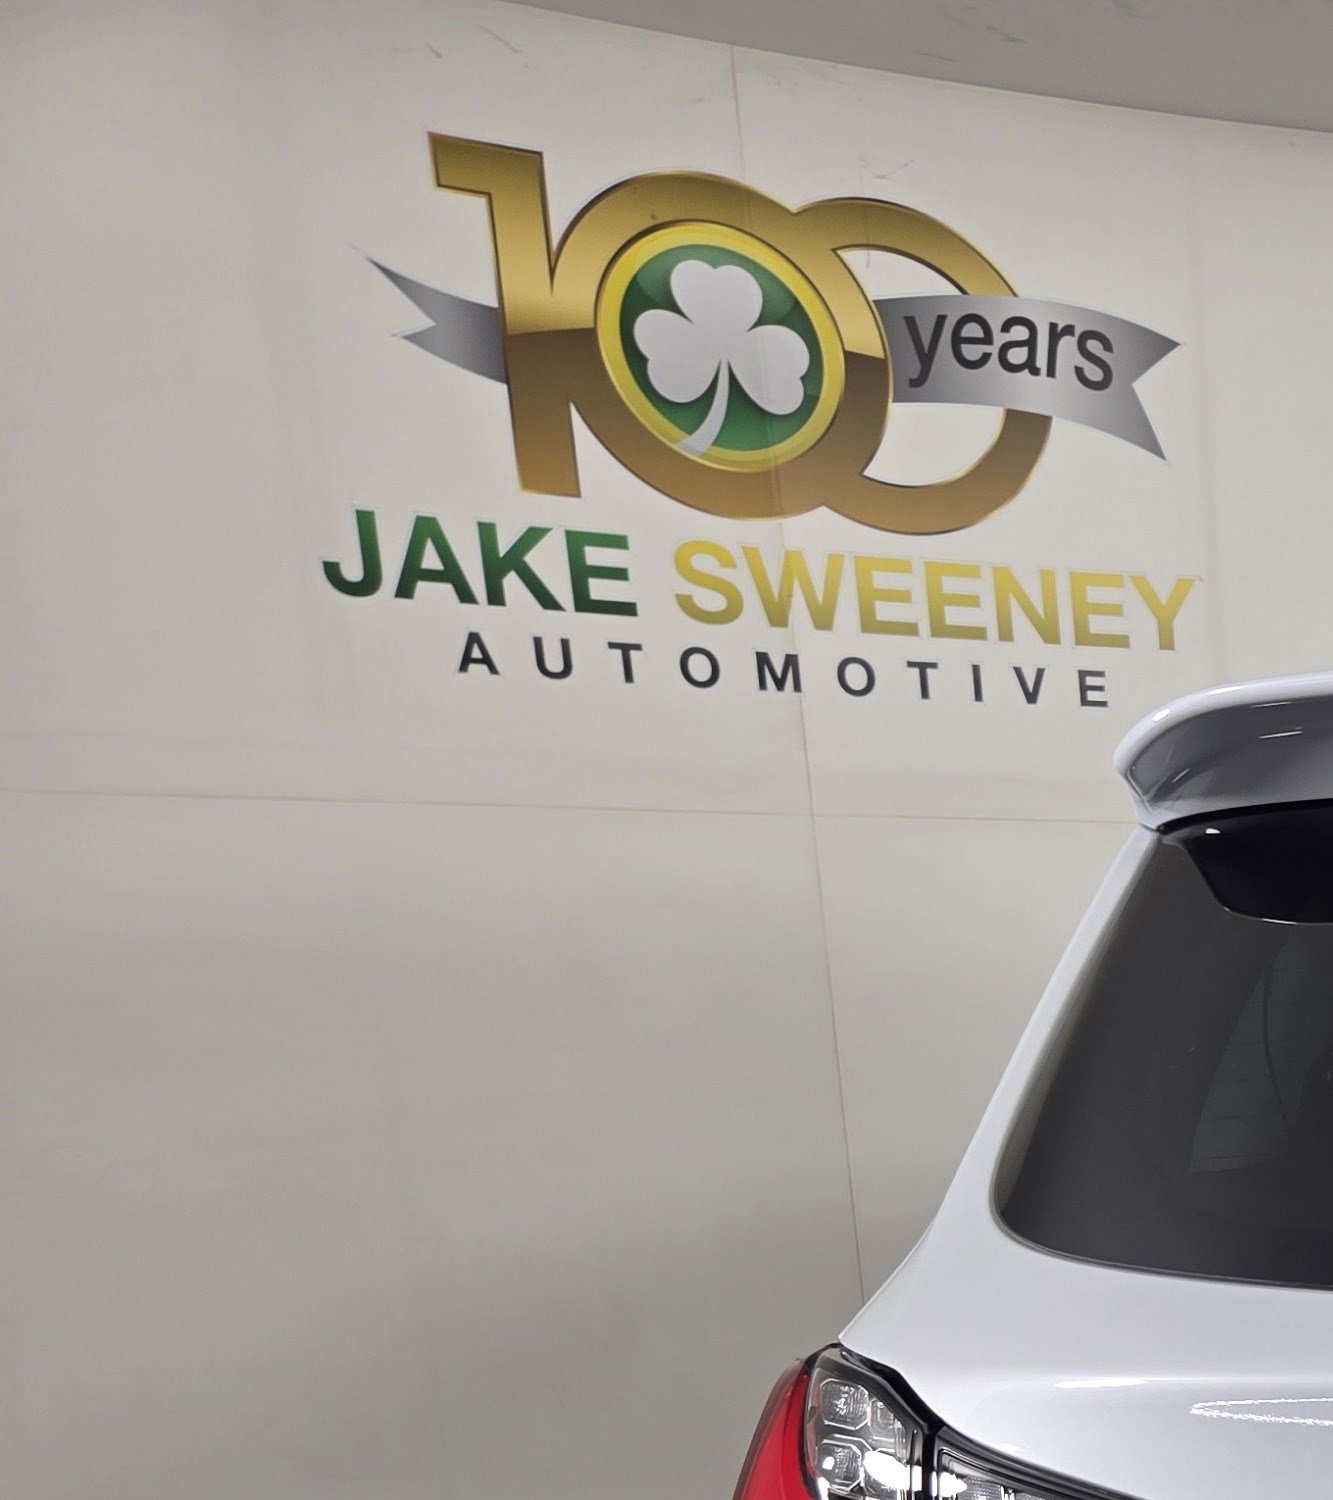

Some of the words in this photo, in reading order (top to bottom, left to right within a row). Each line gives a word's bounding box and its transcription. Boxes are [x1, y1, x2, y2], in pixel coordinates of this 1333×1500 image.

[429, 131, 1052, 536] 100
[903, 311, 1116, 392] years
[322, 508, 640, 618] JAKE
[672, 538, 1196, 652] SWEENEY
[457, 630, 1111, 709] AUTOMOTIVE
